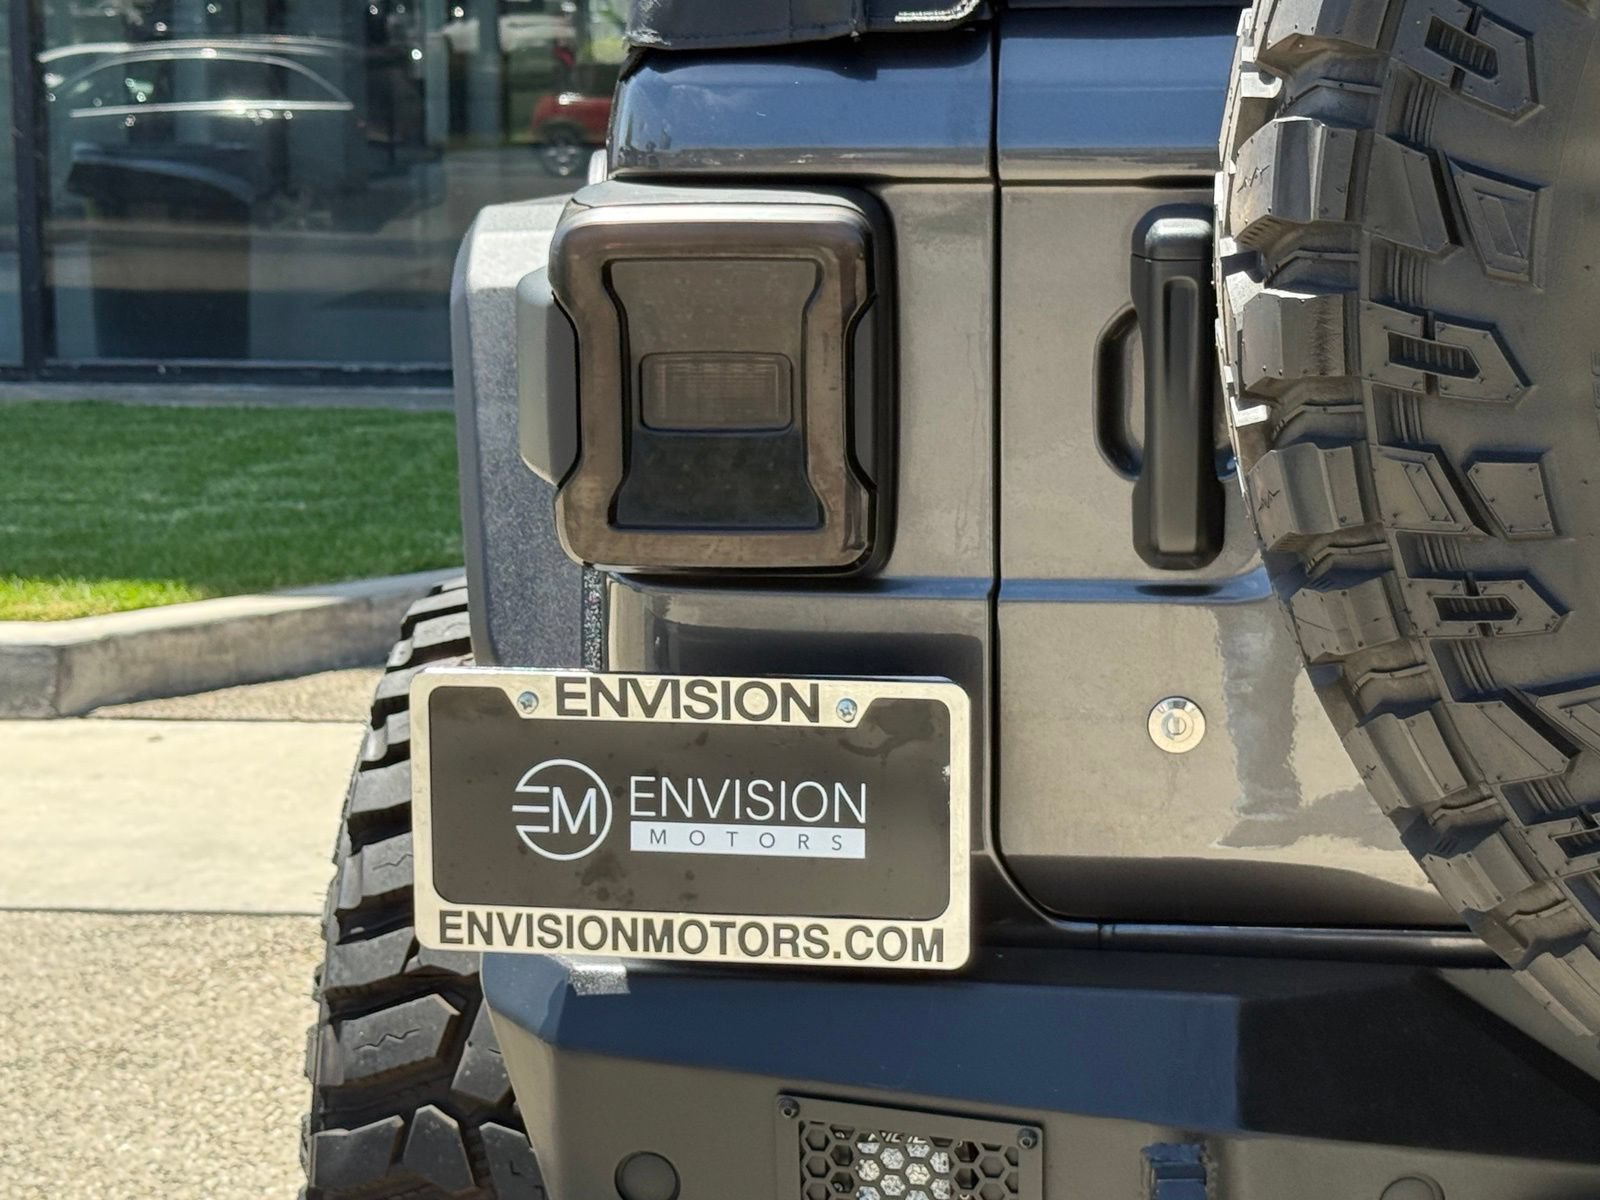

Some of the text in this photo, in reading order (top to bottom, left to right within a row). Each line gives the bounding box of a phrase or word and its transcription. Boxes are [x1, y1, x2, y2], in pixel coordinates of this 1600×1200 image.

[556, 677, 820, 723] ENVISION
[629, 776, 867, 823] ENVISION
[649, 829, 843, 851] MOTORS
[439, 910, 944, 963] ENVISIONMOTORS.COM
